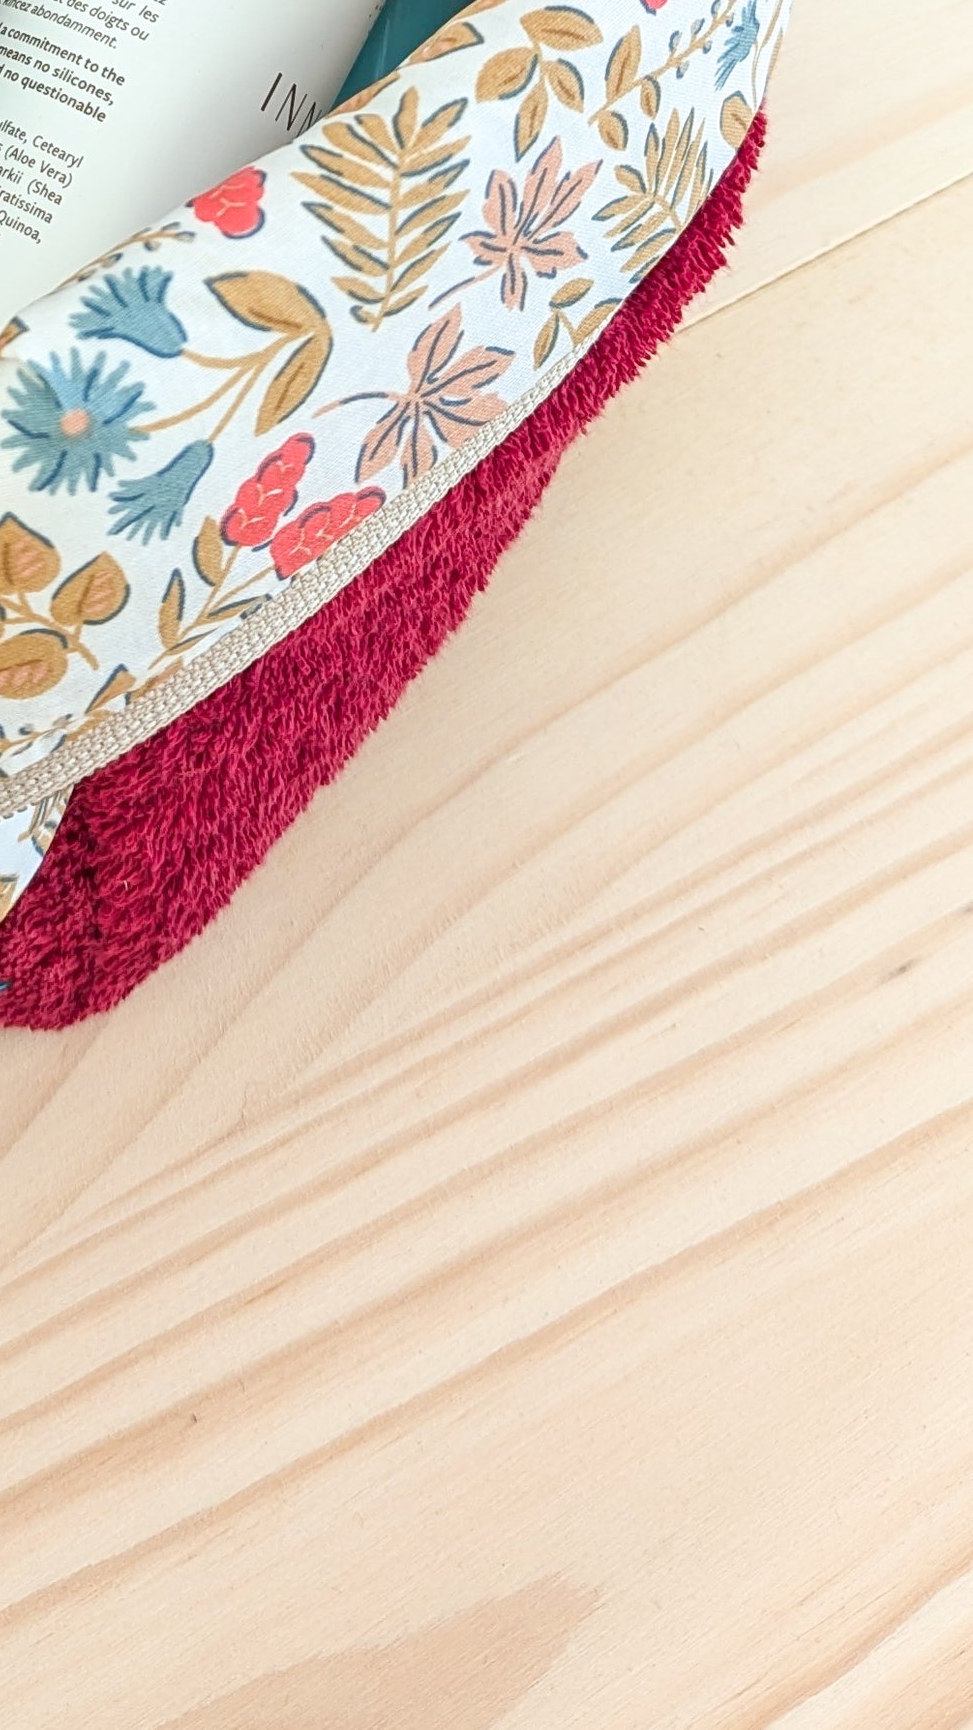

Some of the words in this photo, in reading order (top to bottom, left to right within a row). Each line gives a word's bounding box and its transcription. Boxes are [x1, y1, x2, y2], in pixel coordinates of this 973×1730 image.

[30, 4, 117, 49] abondamment.
[89, 6, 130, 31] doigts
[130, 27, 149, 41] ou
[138, 5, 159, 23] les
[0, 26, 8, 35] a
[7, 28, 83, 65] commitment
[84, 58, 99, 73] to
[101, 67, 125, 86] the
[3, 69, 19, 82] no
[21, 76, 106, 122] questionable
[33, 60, 50, 73] no
[52, 67, 113, 106] silicones,
[4, 145, 36, 168] (Aloe
[40, 160, 72, 189] Vera)
[33, 135, 84, 168] Cetearyl
[27, 179, 62, 205] (Shea
